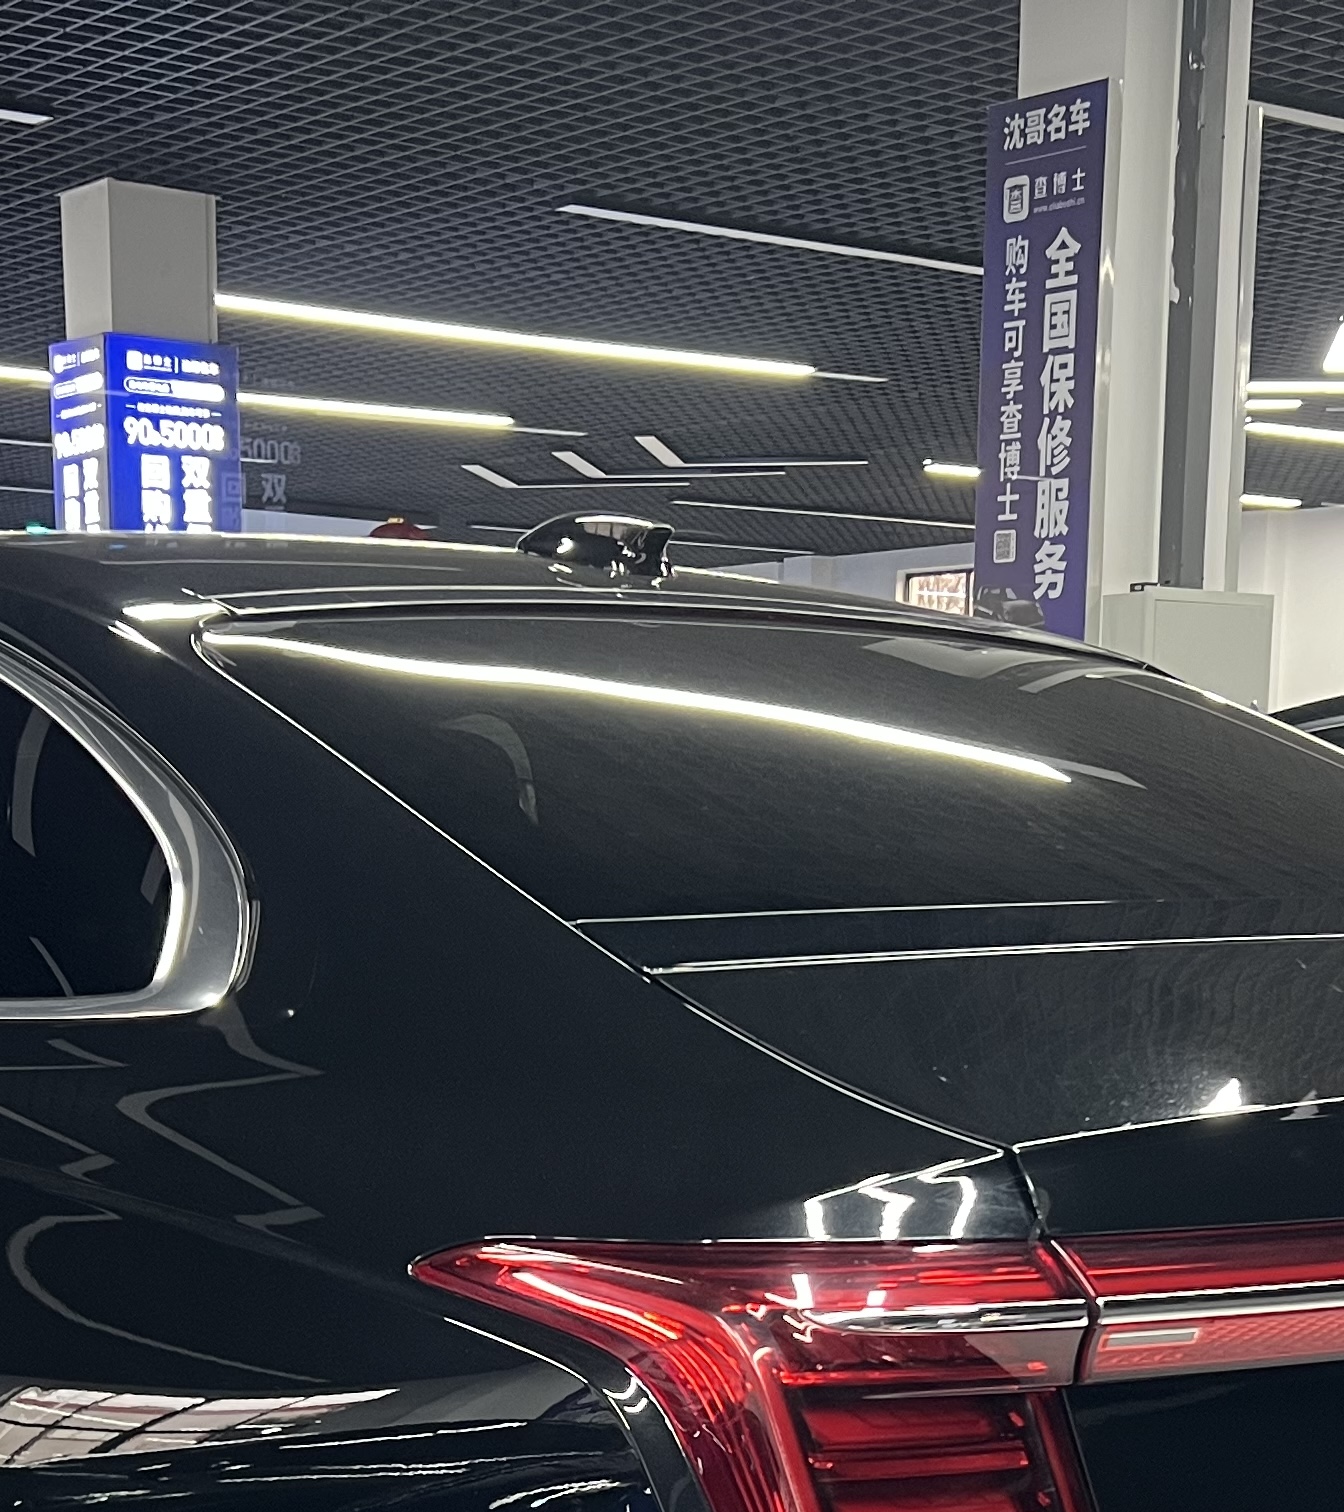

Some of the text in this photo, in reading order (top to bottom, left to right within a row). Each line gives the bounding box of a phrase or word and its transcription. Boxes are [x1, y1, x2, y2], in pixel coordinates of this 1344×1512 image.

[1003, 98, 1091, 151] 沈哥名车
[1034, 167, 1086, 200] 查博士
[996, 234, 1030, 522] 购车可享查博士
[1032, 226, 1082, 600] 全国保修服务
